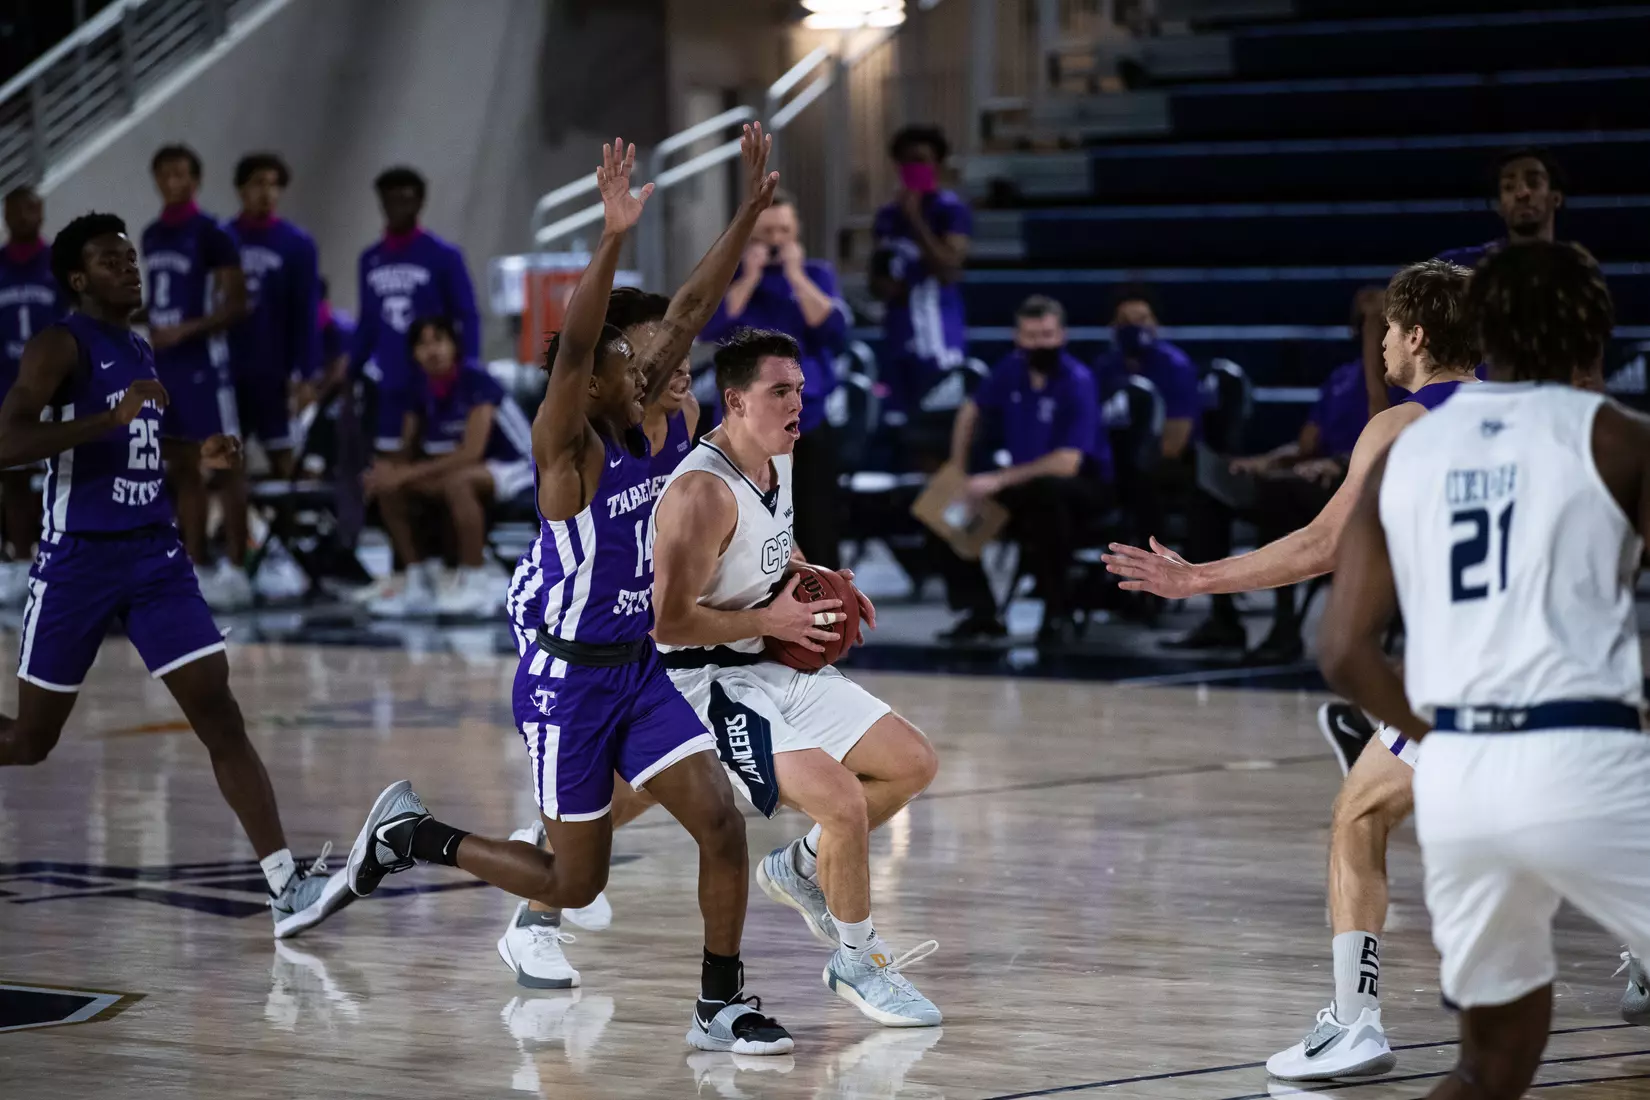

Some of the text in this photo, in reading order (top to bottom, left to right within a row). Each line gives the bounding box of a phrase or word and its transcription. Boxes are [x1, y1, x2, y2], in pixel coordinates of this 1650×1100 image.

[128, 418, 160, 470] 25
[1451, 500, 1514, 604] 21
[724, 713, 765, 785] LANCERS
